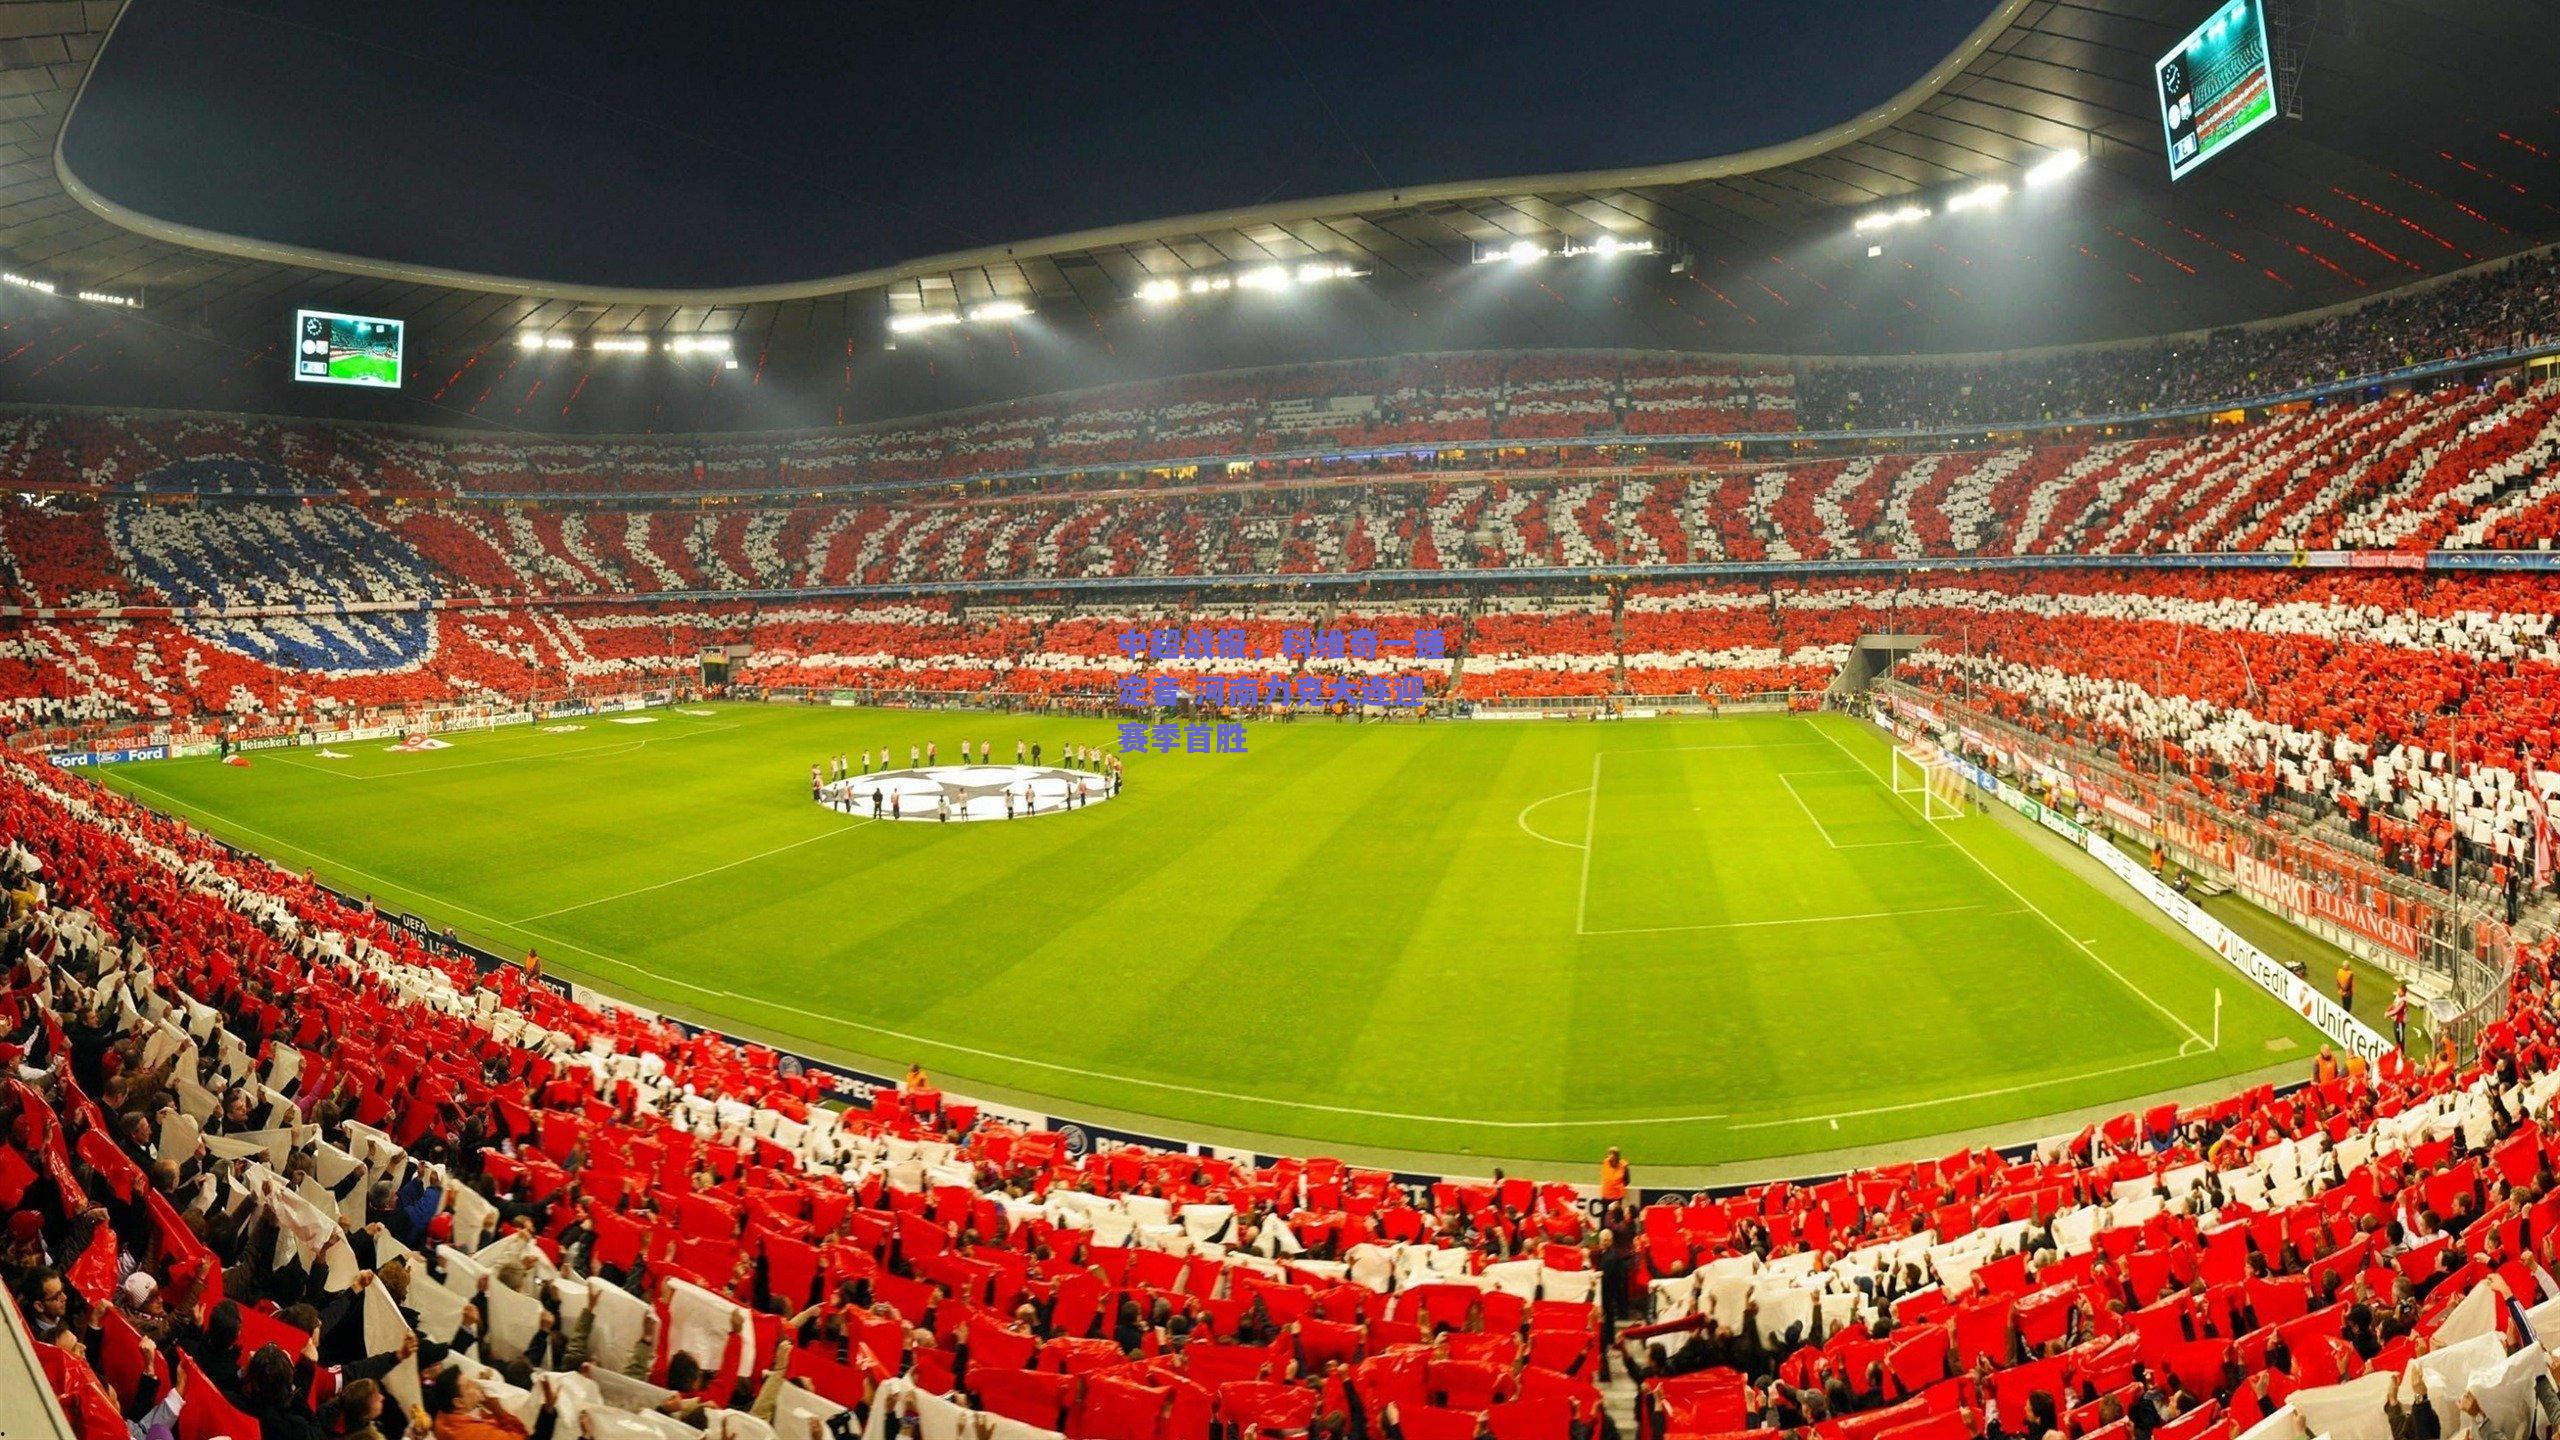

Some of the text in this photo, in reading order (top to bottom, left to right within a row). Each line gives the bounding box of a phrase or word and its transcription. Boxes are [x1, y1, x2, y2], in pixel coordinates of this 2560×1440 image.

[240, 737, 289, 750] Heineken
[249, 725, 287, 739] SHARKS
[51, 754, 88, 767] Ford
[128, 748, 163, 761] Ford
[2235, 853, 2312, 914] NEUMARKT
[2154, 882, 2189, 924] PS3
[402, 915, 428, 934] UEFA
[2315, 889, 2413, 950] ELLWANGEN
[2230, 936, 2289, 1001] UniCredit
[2316, 996, 2392, 1063] UniCredi
